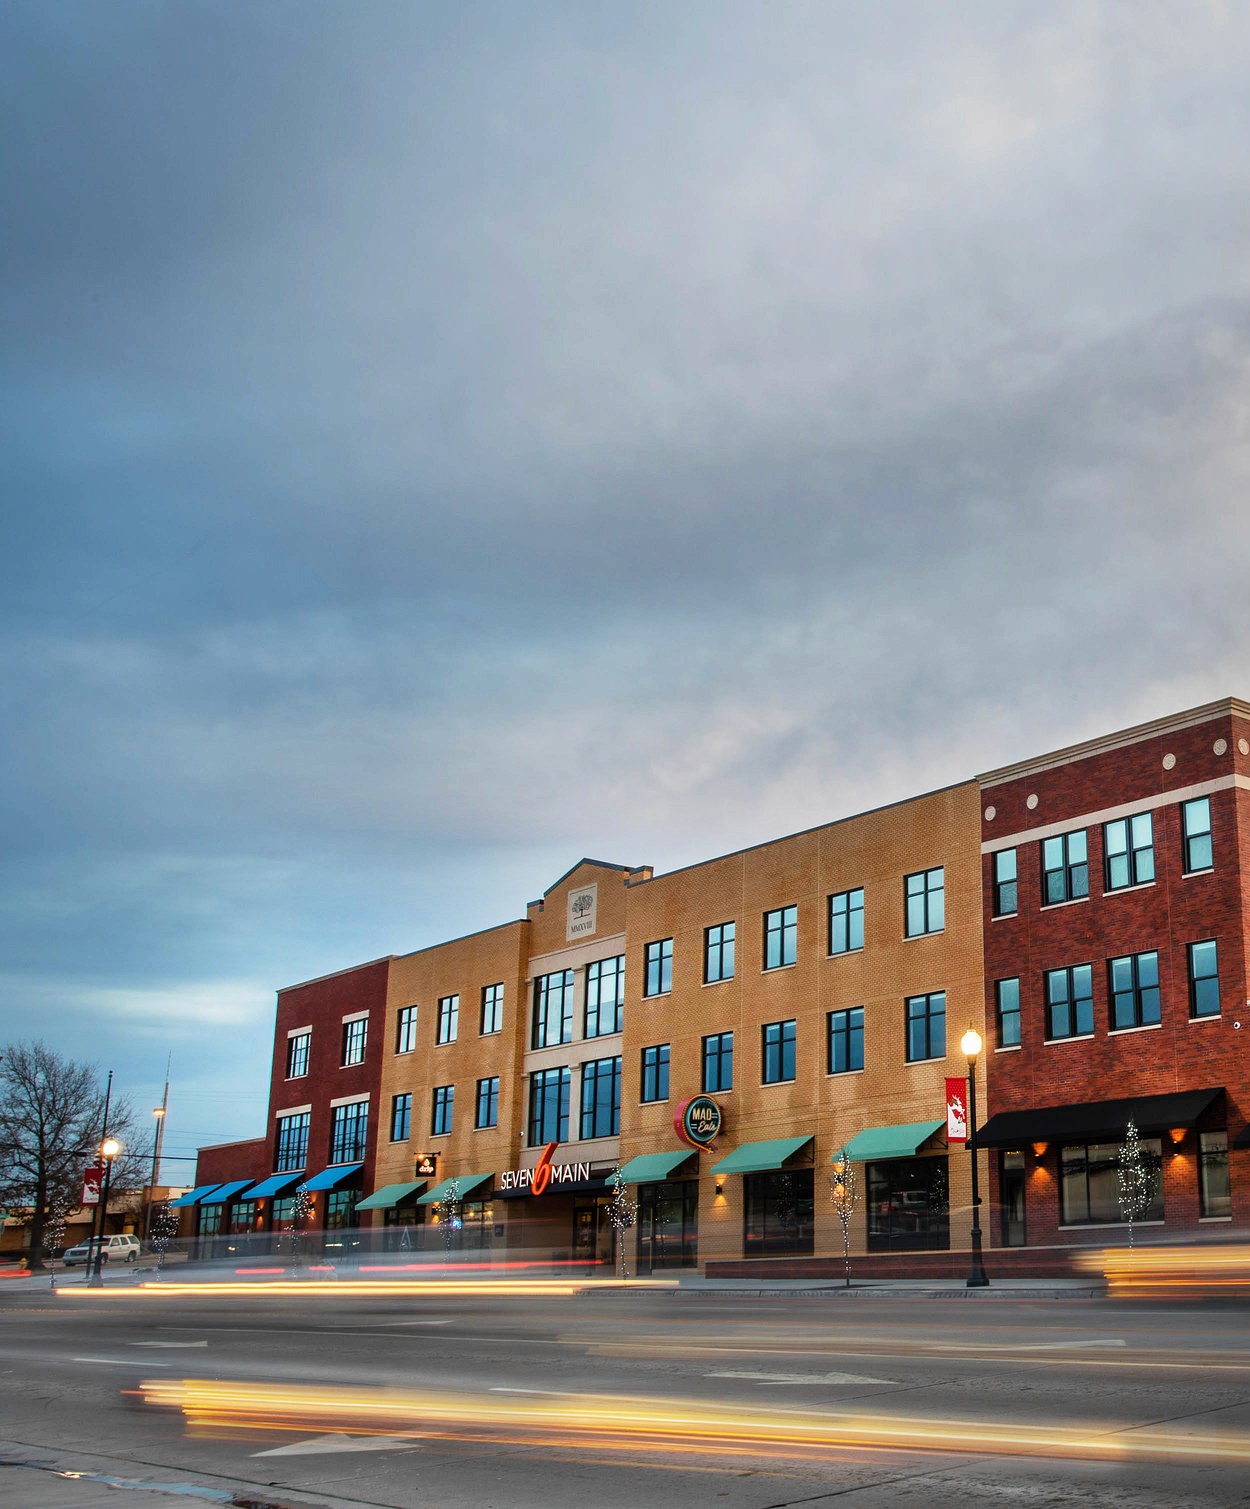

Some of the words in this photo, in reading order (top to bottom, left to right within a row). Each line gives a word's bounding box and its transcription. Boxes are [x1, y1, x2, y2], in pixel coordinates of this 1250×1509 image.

[692, 1107, 713, 1121] MAD
[500, 1168, 535, 1190] SEVEN
[531, 1142, 559, 1196] 6
[550, 1162, 590, 1184] MAIN
